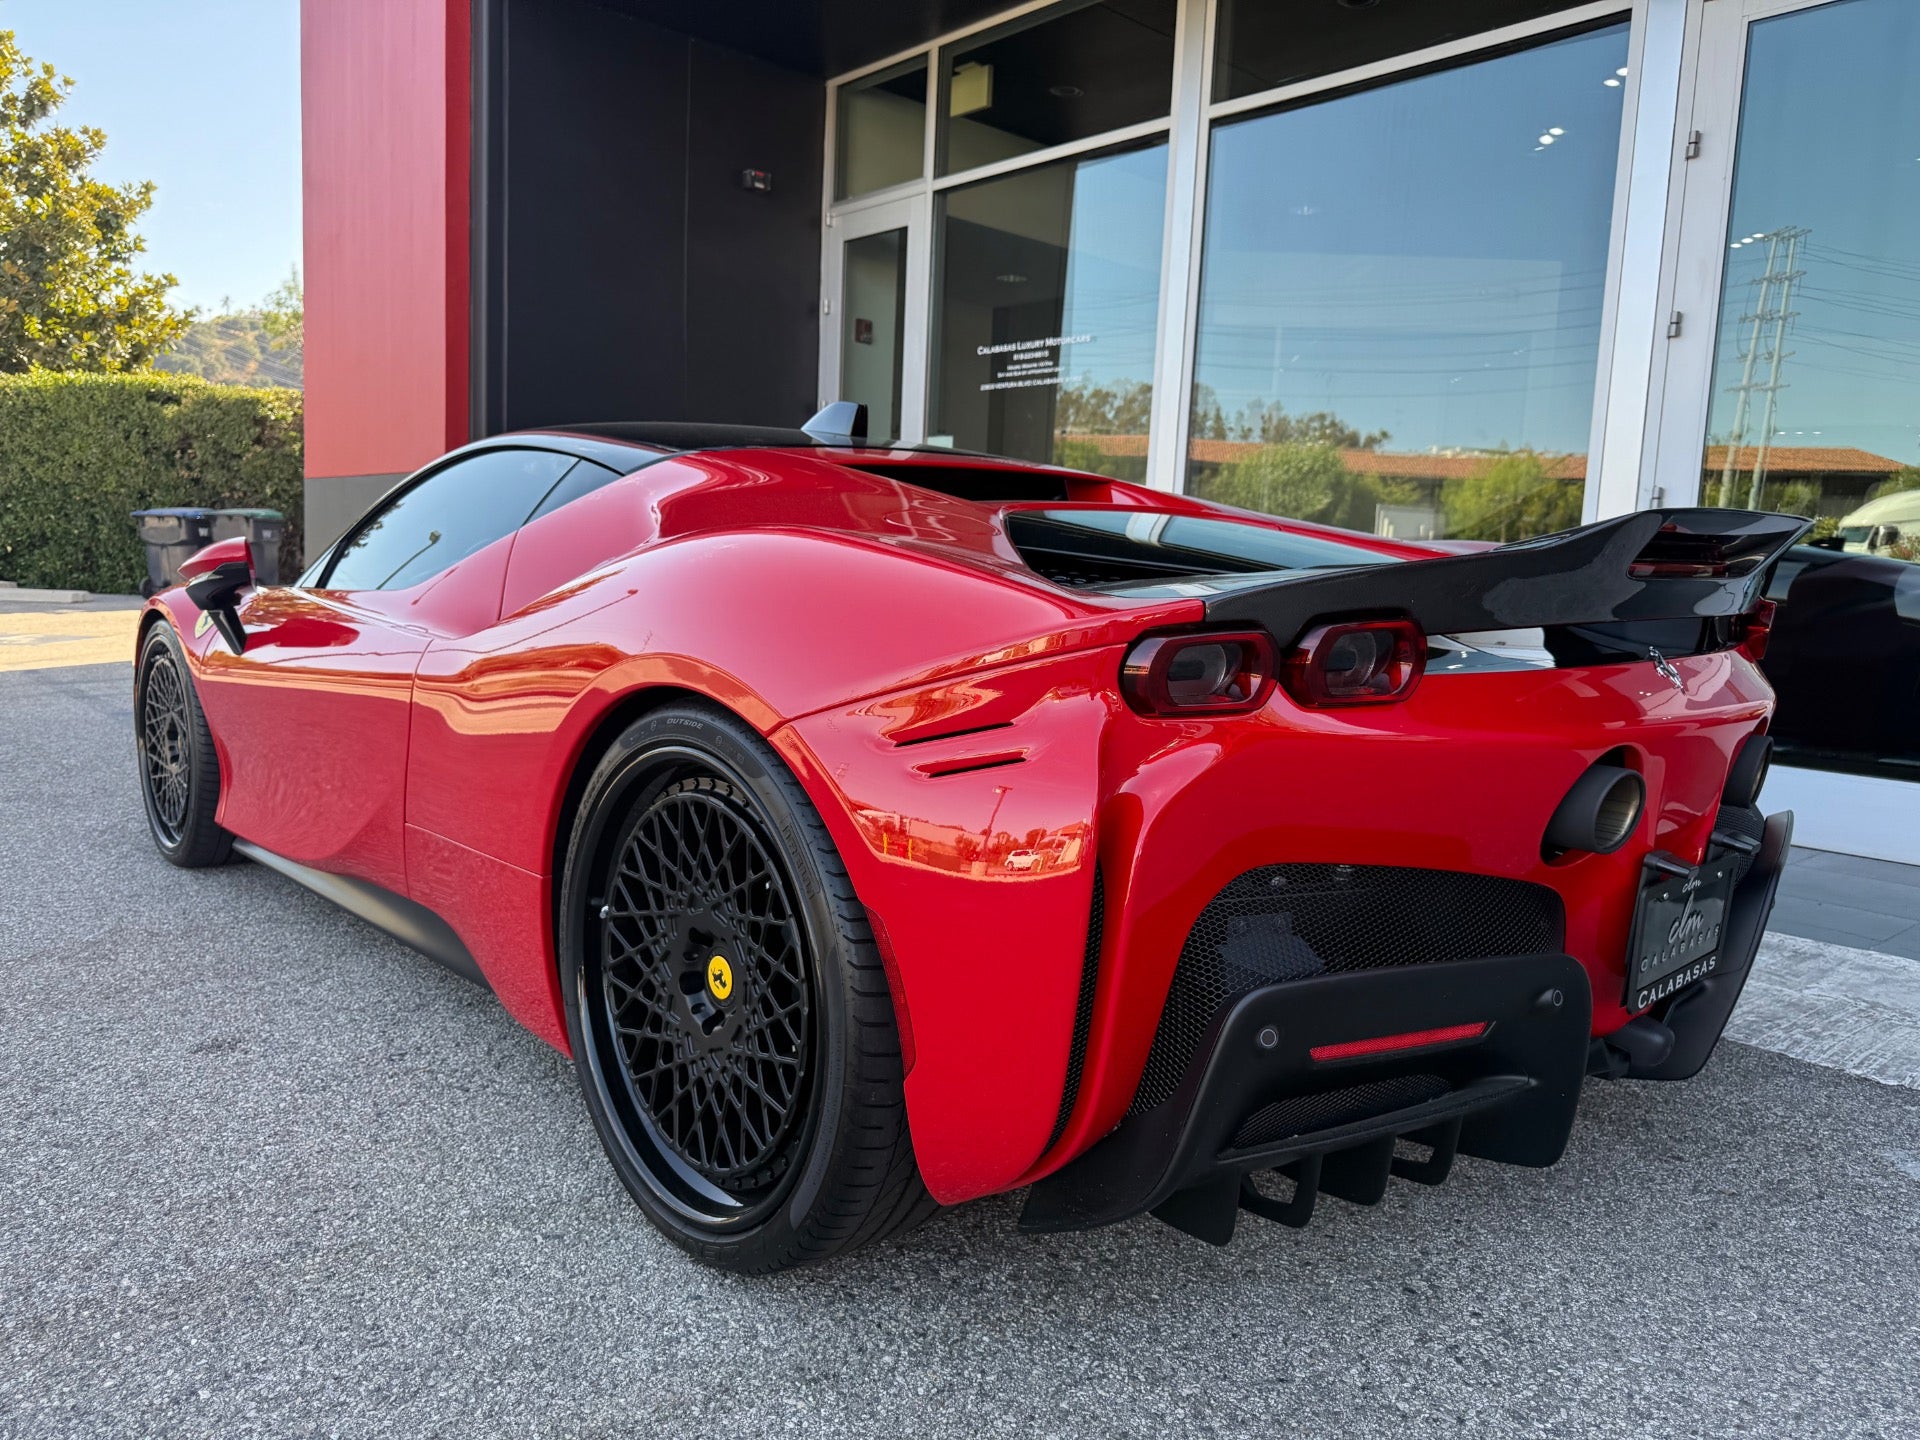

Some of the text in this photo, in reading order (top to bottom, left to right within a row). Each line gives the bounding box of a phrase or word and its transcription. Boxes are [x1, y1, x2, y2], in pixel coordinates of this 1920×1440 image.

[977, 336, 1091, 355] CALABASAS LUXURY MOTORCARS
[666, 718, 704, 730] OUTSIDE
[1640, 926, 1719, 971] CALABASAS
[1638, 956, 1716, 1009] CALABASAS
